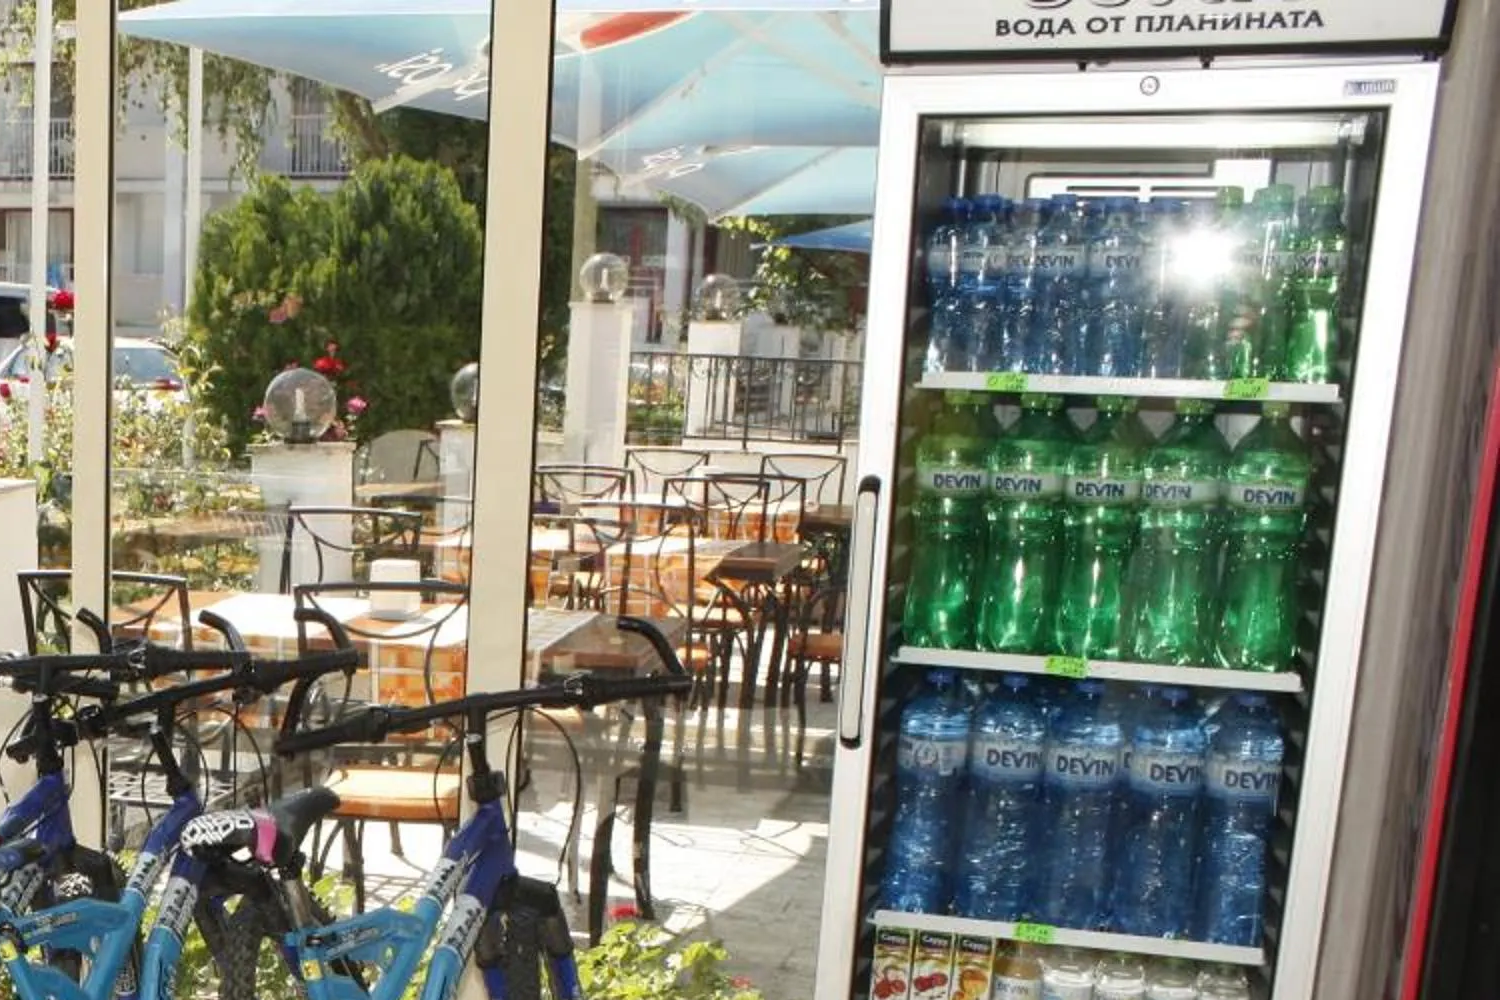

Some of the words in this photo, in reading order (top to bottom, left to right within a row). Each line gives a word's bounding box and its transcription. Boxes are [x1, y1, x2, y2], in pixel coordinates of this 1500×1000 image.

[995, 17, 1076, 38] ВОДА
[1086, 16, 1126, 34] ОТ
[1135, 10, 1325, 33] ПЛАНИНАТА
[932, 473, 981, 489] DEVIN
[995, 477, 1042, 492] DEVIN
[1075, 480, 1125, 497] DEVIN
[1145, 484, 1192, 499] DEVIN
[1243, 488, 1296, 504] DEVIN
[986, 748, 1045, 769] DEVIN
[1056, 754, 1115, 776] DEVIN
